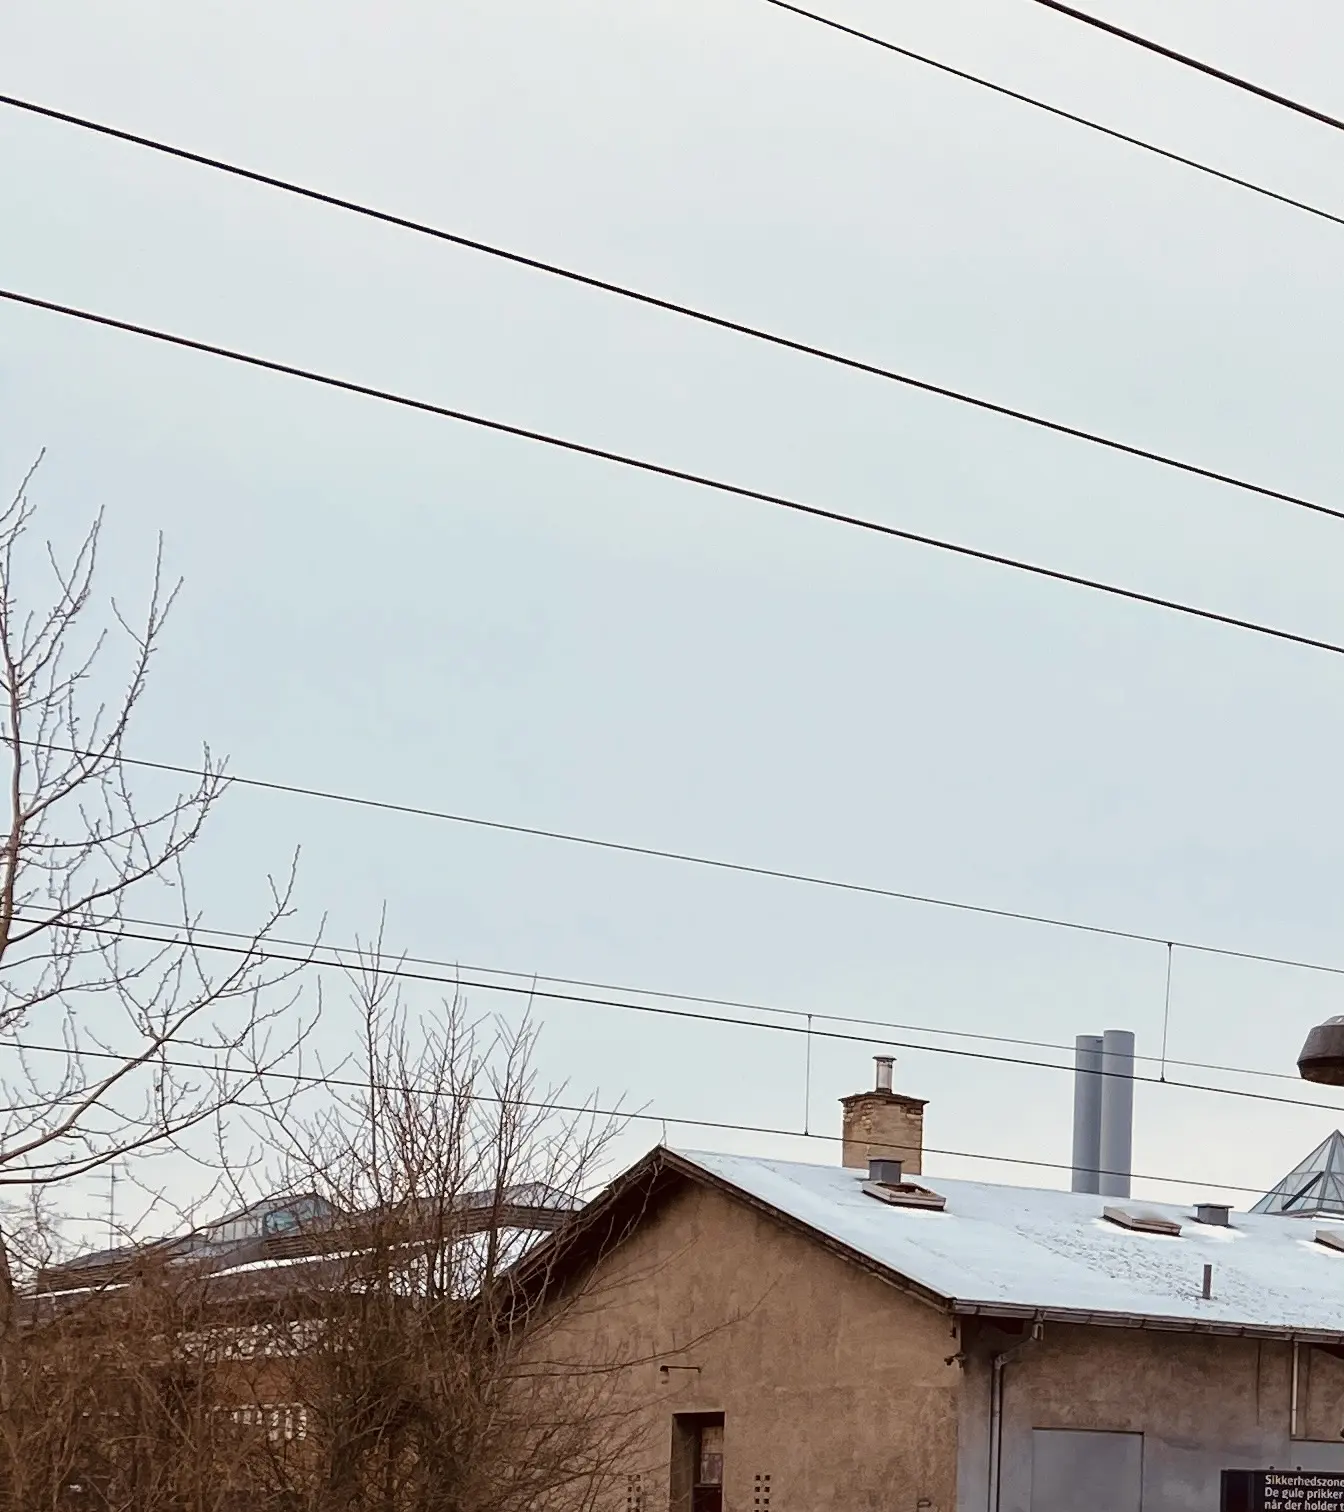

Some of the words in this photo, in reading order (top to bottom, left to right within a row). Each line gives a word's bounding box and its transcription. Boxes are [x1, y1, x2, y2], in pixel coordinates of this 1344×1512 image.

[1264, 1486, 1280, 1498] De
[1281, 1488, 1305, 1500] gule
[1306, 1489, 1344, 1501] prikker
[1264, 1499, 1283, 1510] når
[1284, 1499, 1303, 1511] der
[1304, 1500, 1339, 1512] holder
